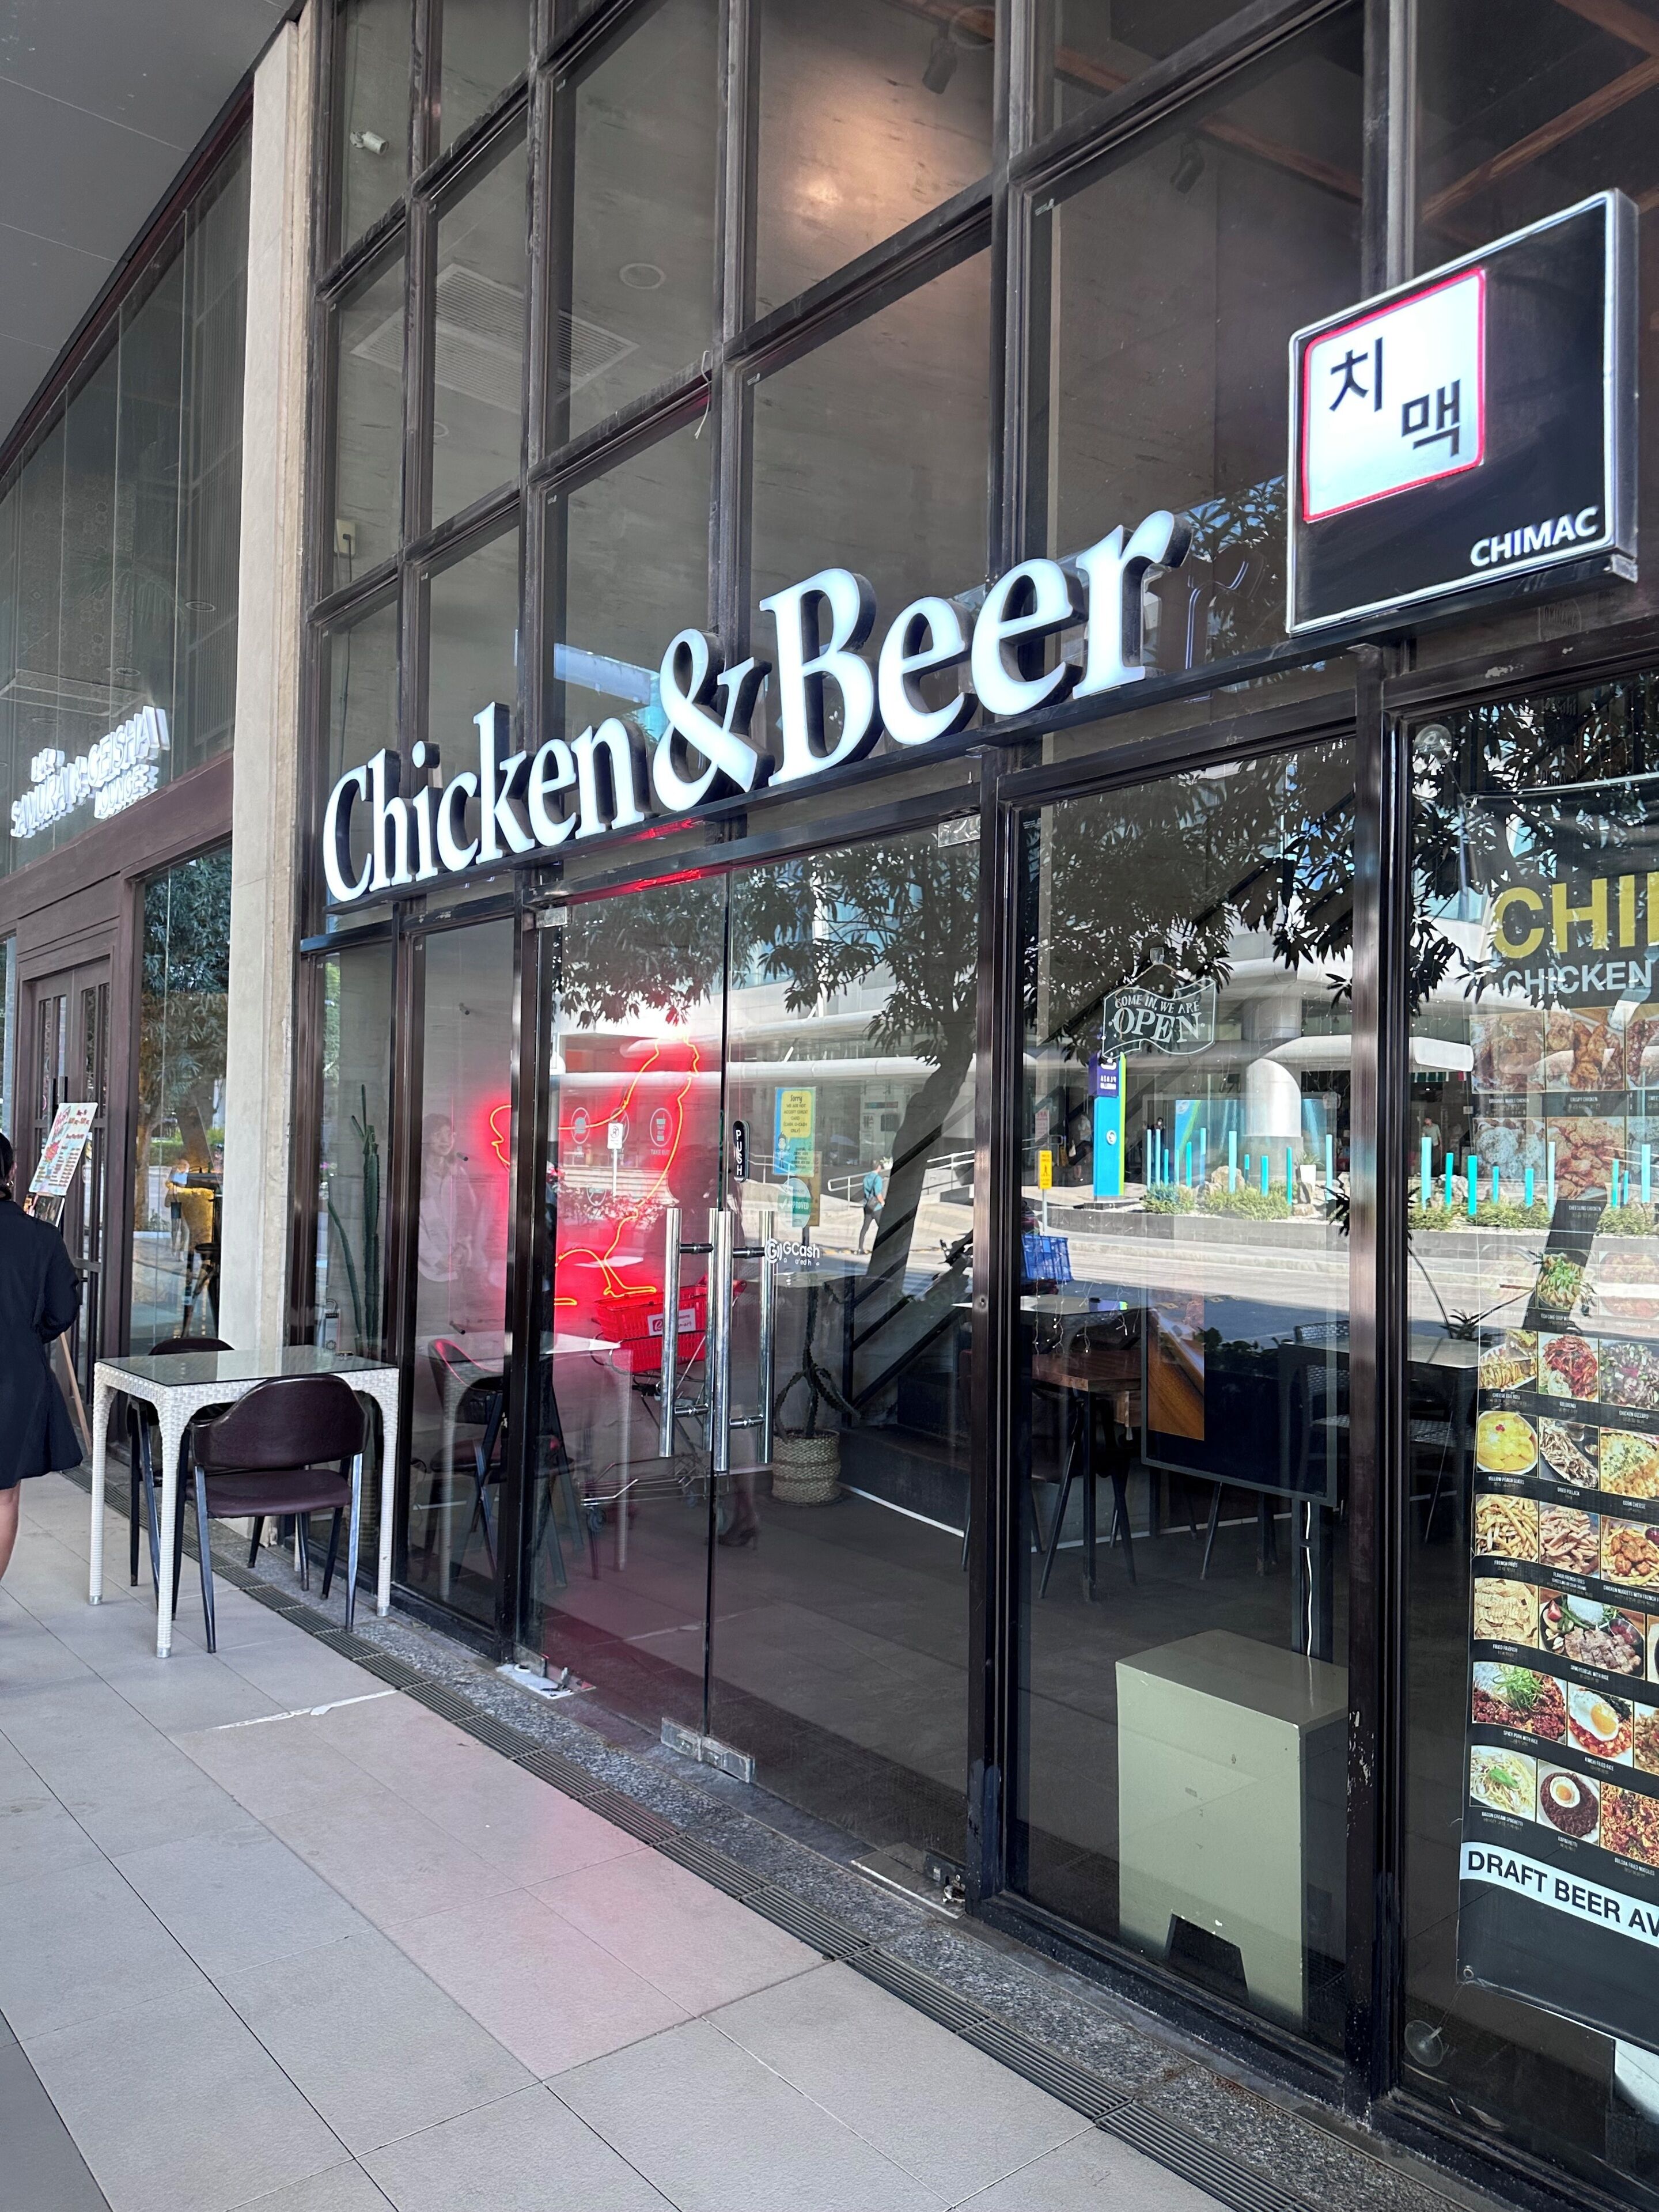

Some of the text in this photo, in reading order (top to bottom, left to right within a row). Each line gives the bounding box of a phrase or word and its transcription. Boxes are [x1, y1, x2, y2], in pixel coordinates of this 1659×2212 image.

[1329, 337, 1461, 457] 치맥
[1470, 505, 1599, 567] CHIMAC
[323, 510, 1178, 902] Chicken & Beer
[88, 706, 160, 788] GEISHA
[1502, 960, 1652, 995] CHICKEN
[1113, 1007, 1202, 1043] OPEN
[1115, 994, 1142, 1008] COME
[1160, 1001, 1175, 1013] WE
[1177, 1001, 1200, 1014] ARE
[790, 1094, 802, 1103] Sorry
[783, 1241, 820, 1259] GCash
[1468, 1851, 1548, 1893] DRAFT
[1554, 1878, 1620, 1923] BEER
